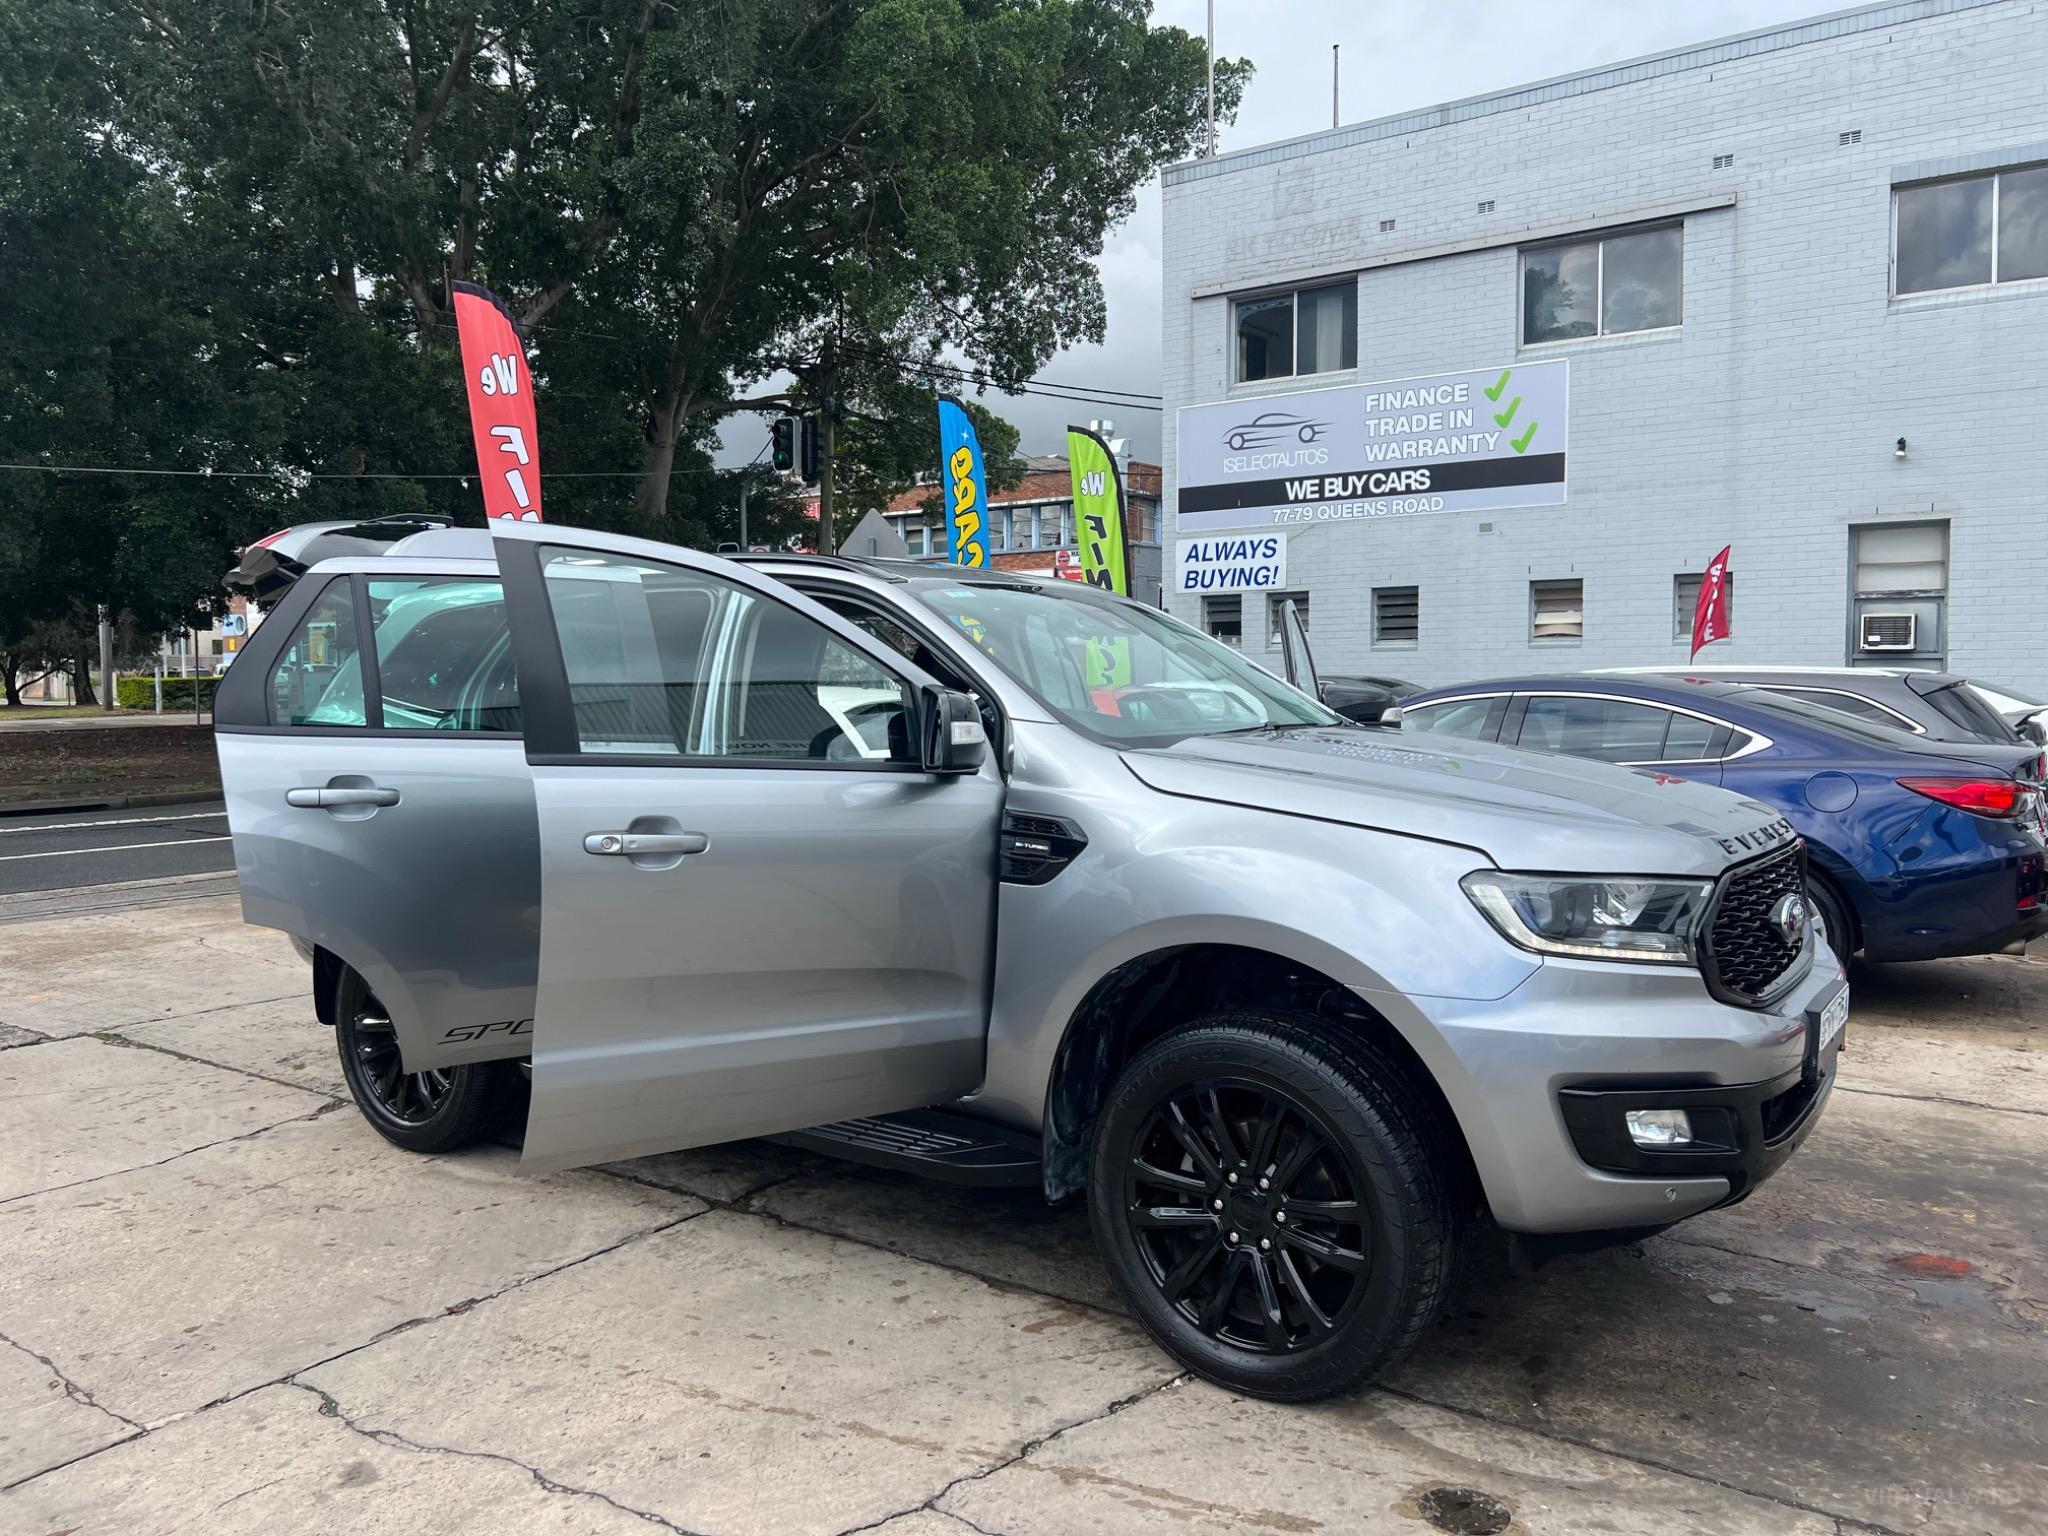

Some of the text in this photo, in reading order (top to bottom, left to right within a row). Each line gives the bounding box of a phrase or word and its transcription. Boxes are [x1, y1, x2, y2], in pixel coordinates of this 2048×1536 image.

[1364, 383, 1469, 413] FINANCE
[1364, 408, 1473, 438] TRADE IN
[1223, 448, 1329, 474] ISELECTAUTOS
[1365, 432, 1502, 463] WARRANTY
[1285, 468, 1431, 501] WE BUY CARS
[1272, 496, 1444, 523] 77-79 QUEENS ROAD
[1185, 538, 1278, 563] ALWAYS
[1184, 564, 1278, 590] BUYING!
[437, 1018, 535, 1046] SPO
